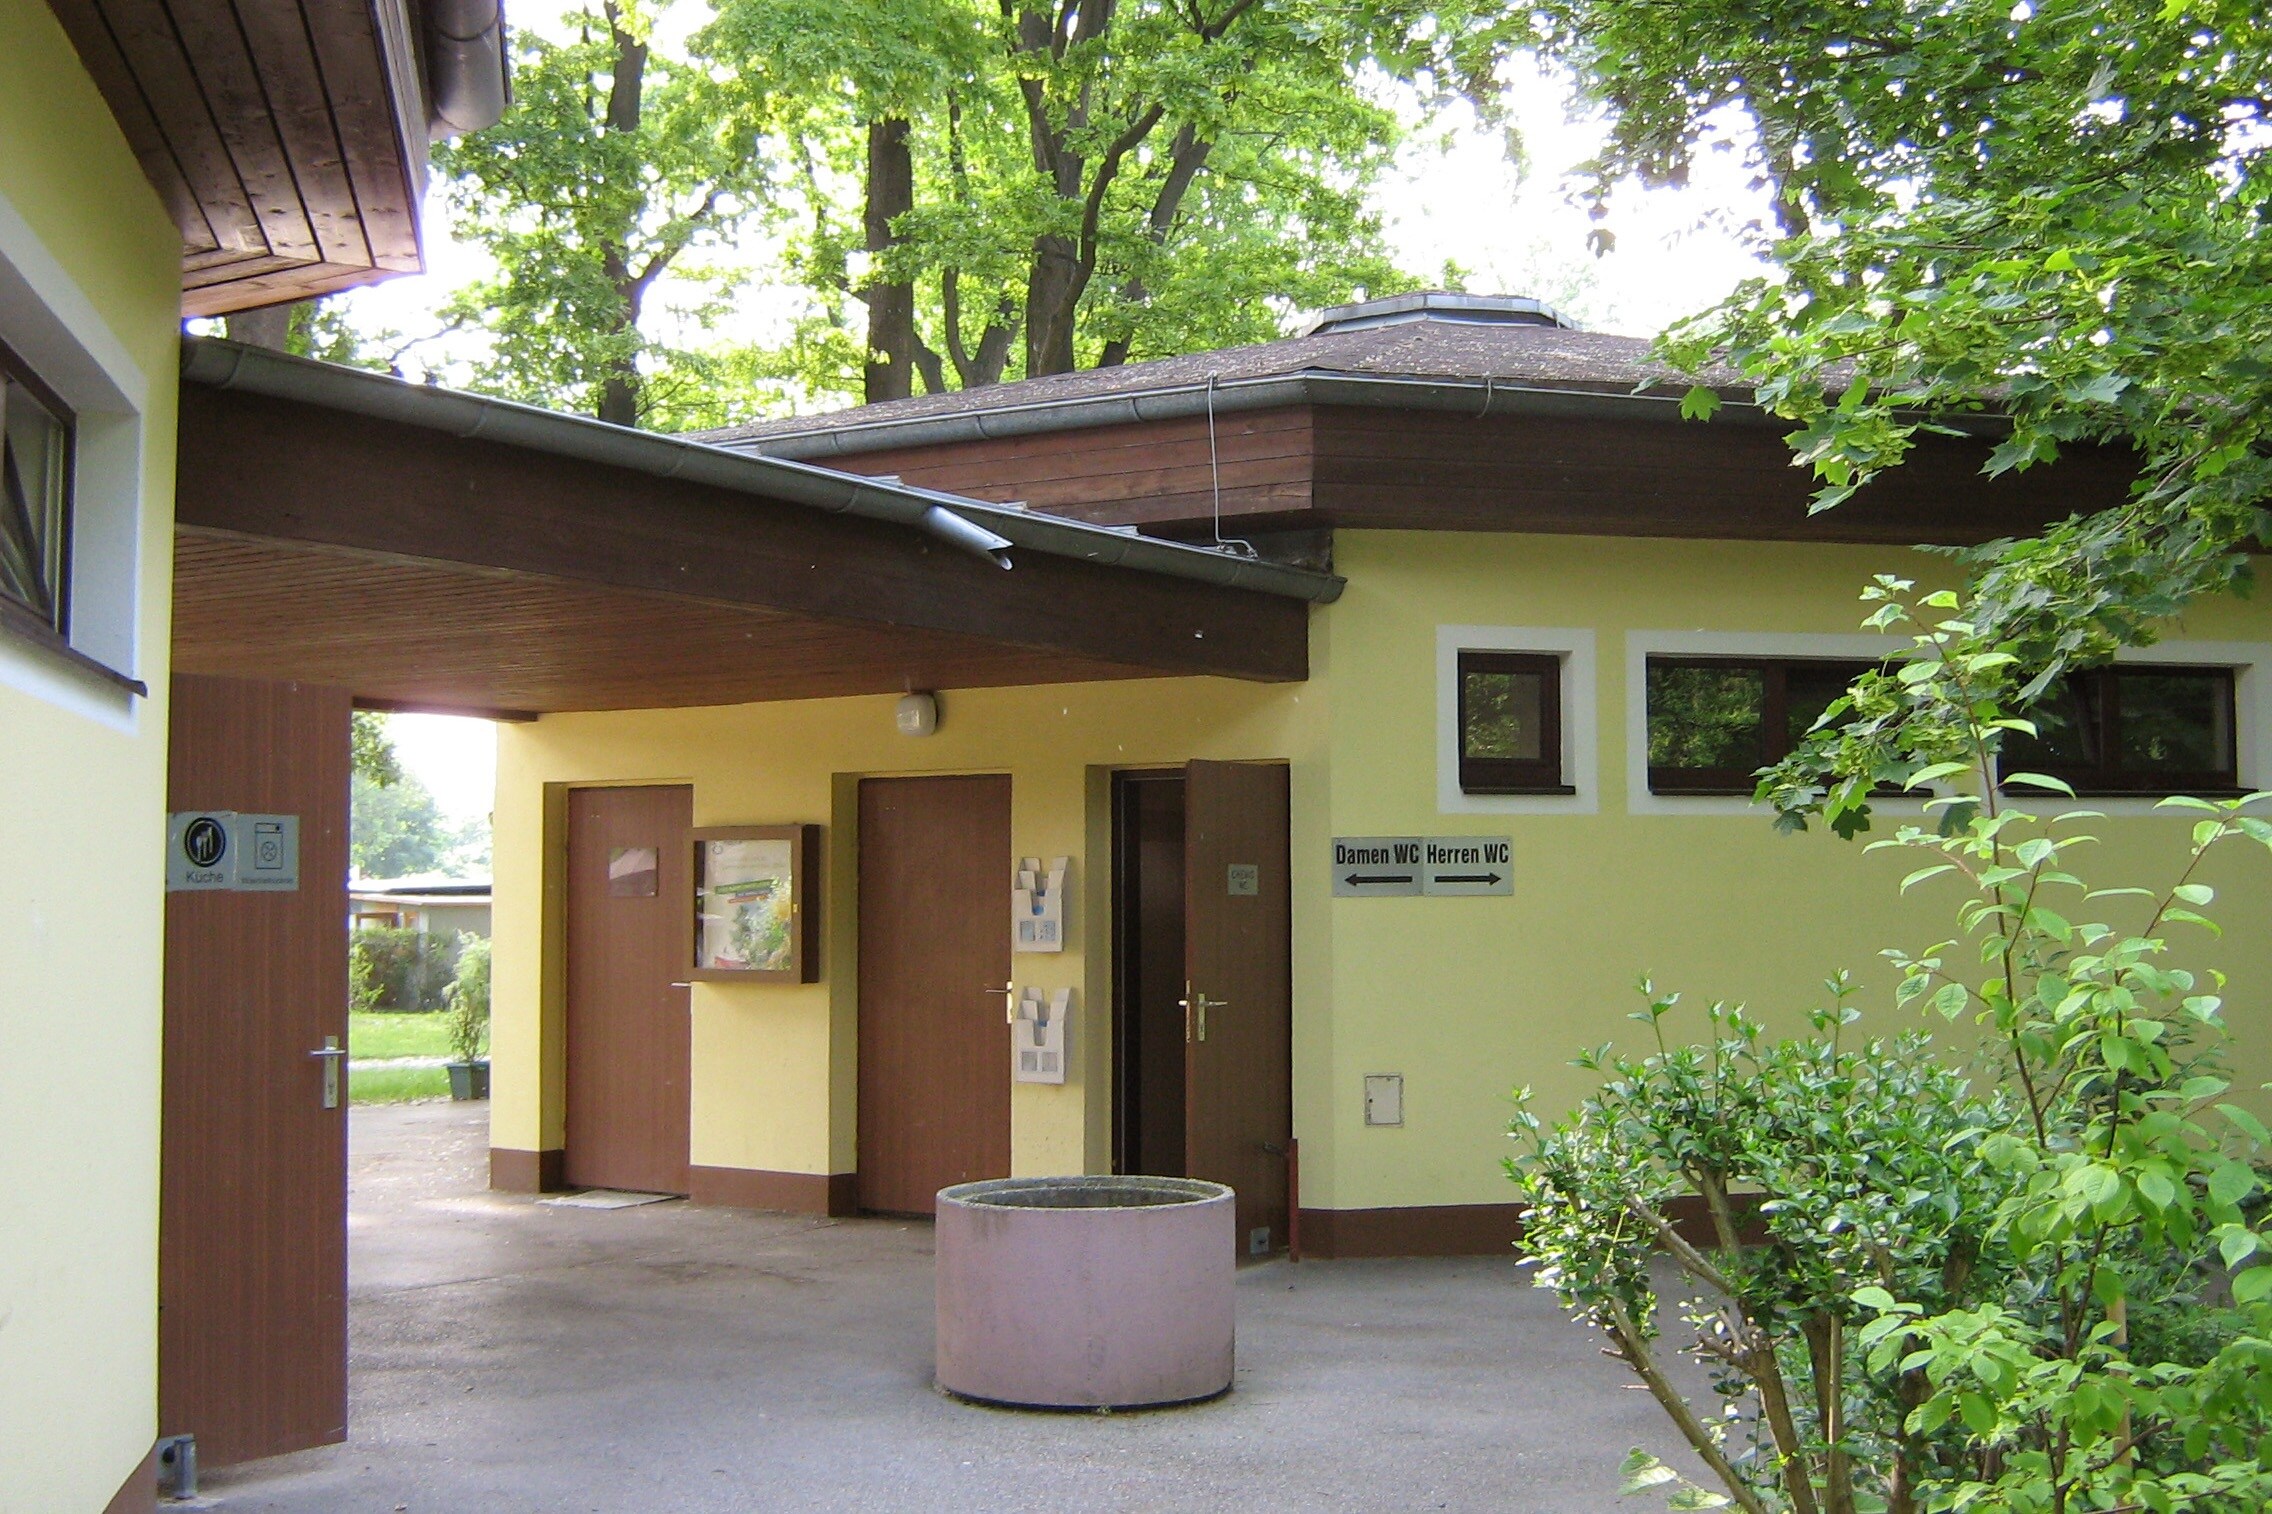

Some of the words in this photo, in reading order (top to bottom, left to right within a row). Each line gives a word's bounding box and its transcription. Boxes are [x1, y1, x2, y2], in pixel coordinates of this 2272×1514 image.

[1335, 844, 1389, 865] Damen
[1393, 843, 1420, 865] WC
[1426, 844, 1479, 864] Herren
[1483, 843, 1509, 864] WC
